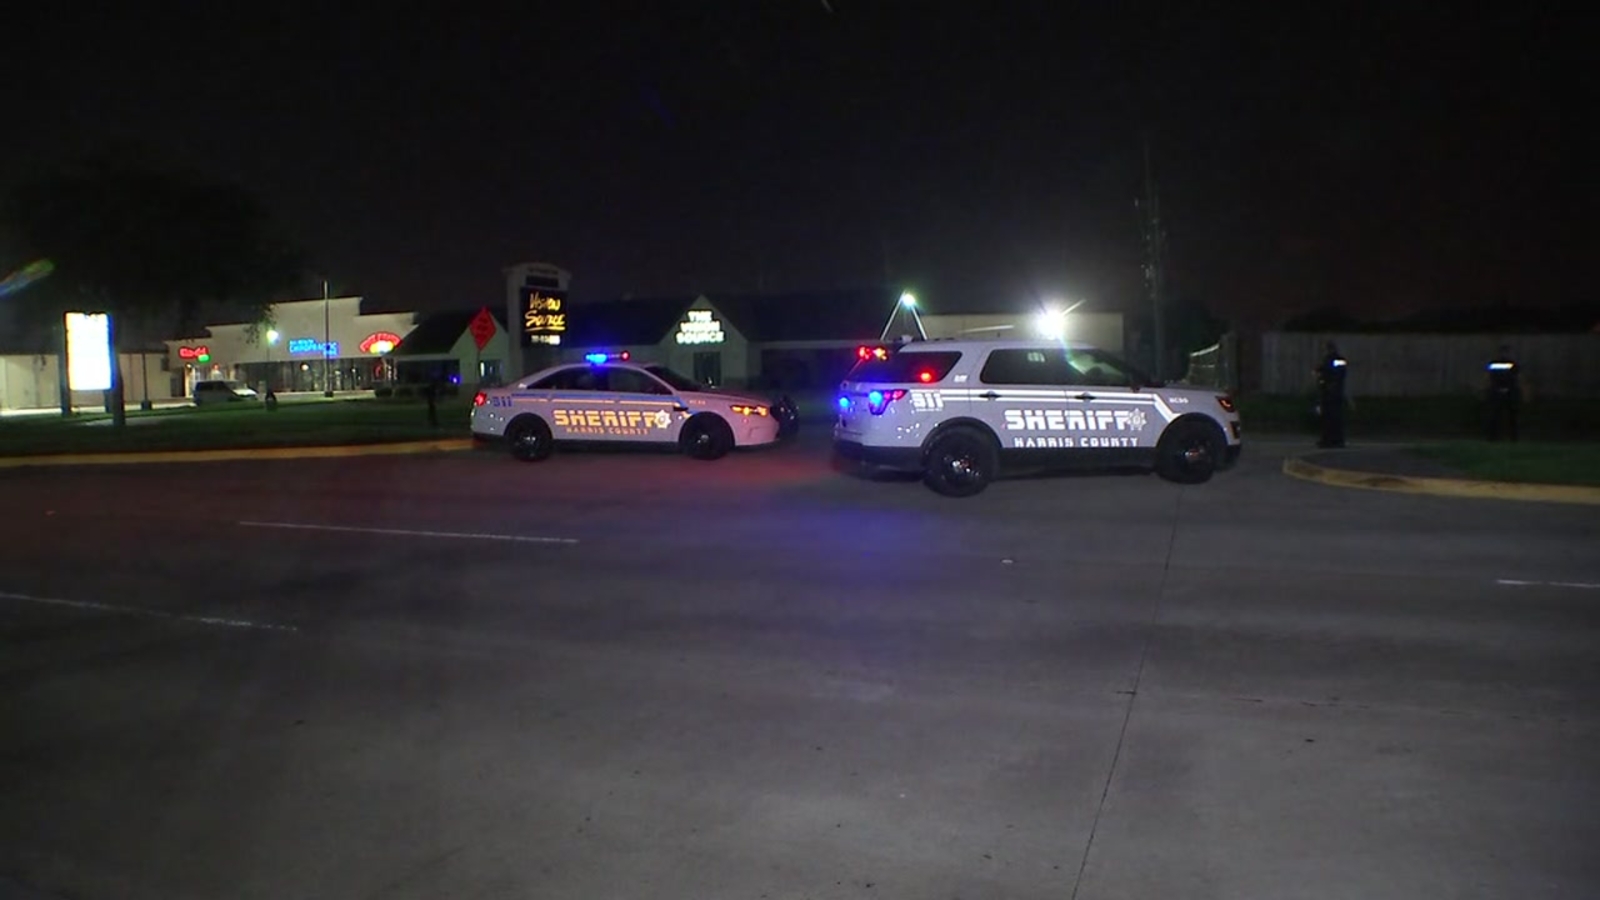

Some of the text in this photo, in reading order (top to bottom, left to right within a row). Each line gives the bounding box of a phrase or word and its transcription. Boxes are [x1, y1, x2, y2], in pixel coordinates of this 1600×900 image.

[553, 409, 657, 428] SHERIFF
[1004, 409, 1130, 430] SHERIFF
[1014, 437, 1138, 448] HARRIS COUNTY
